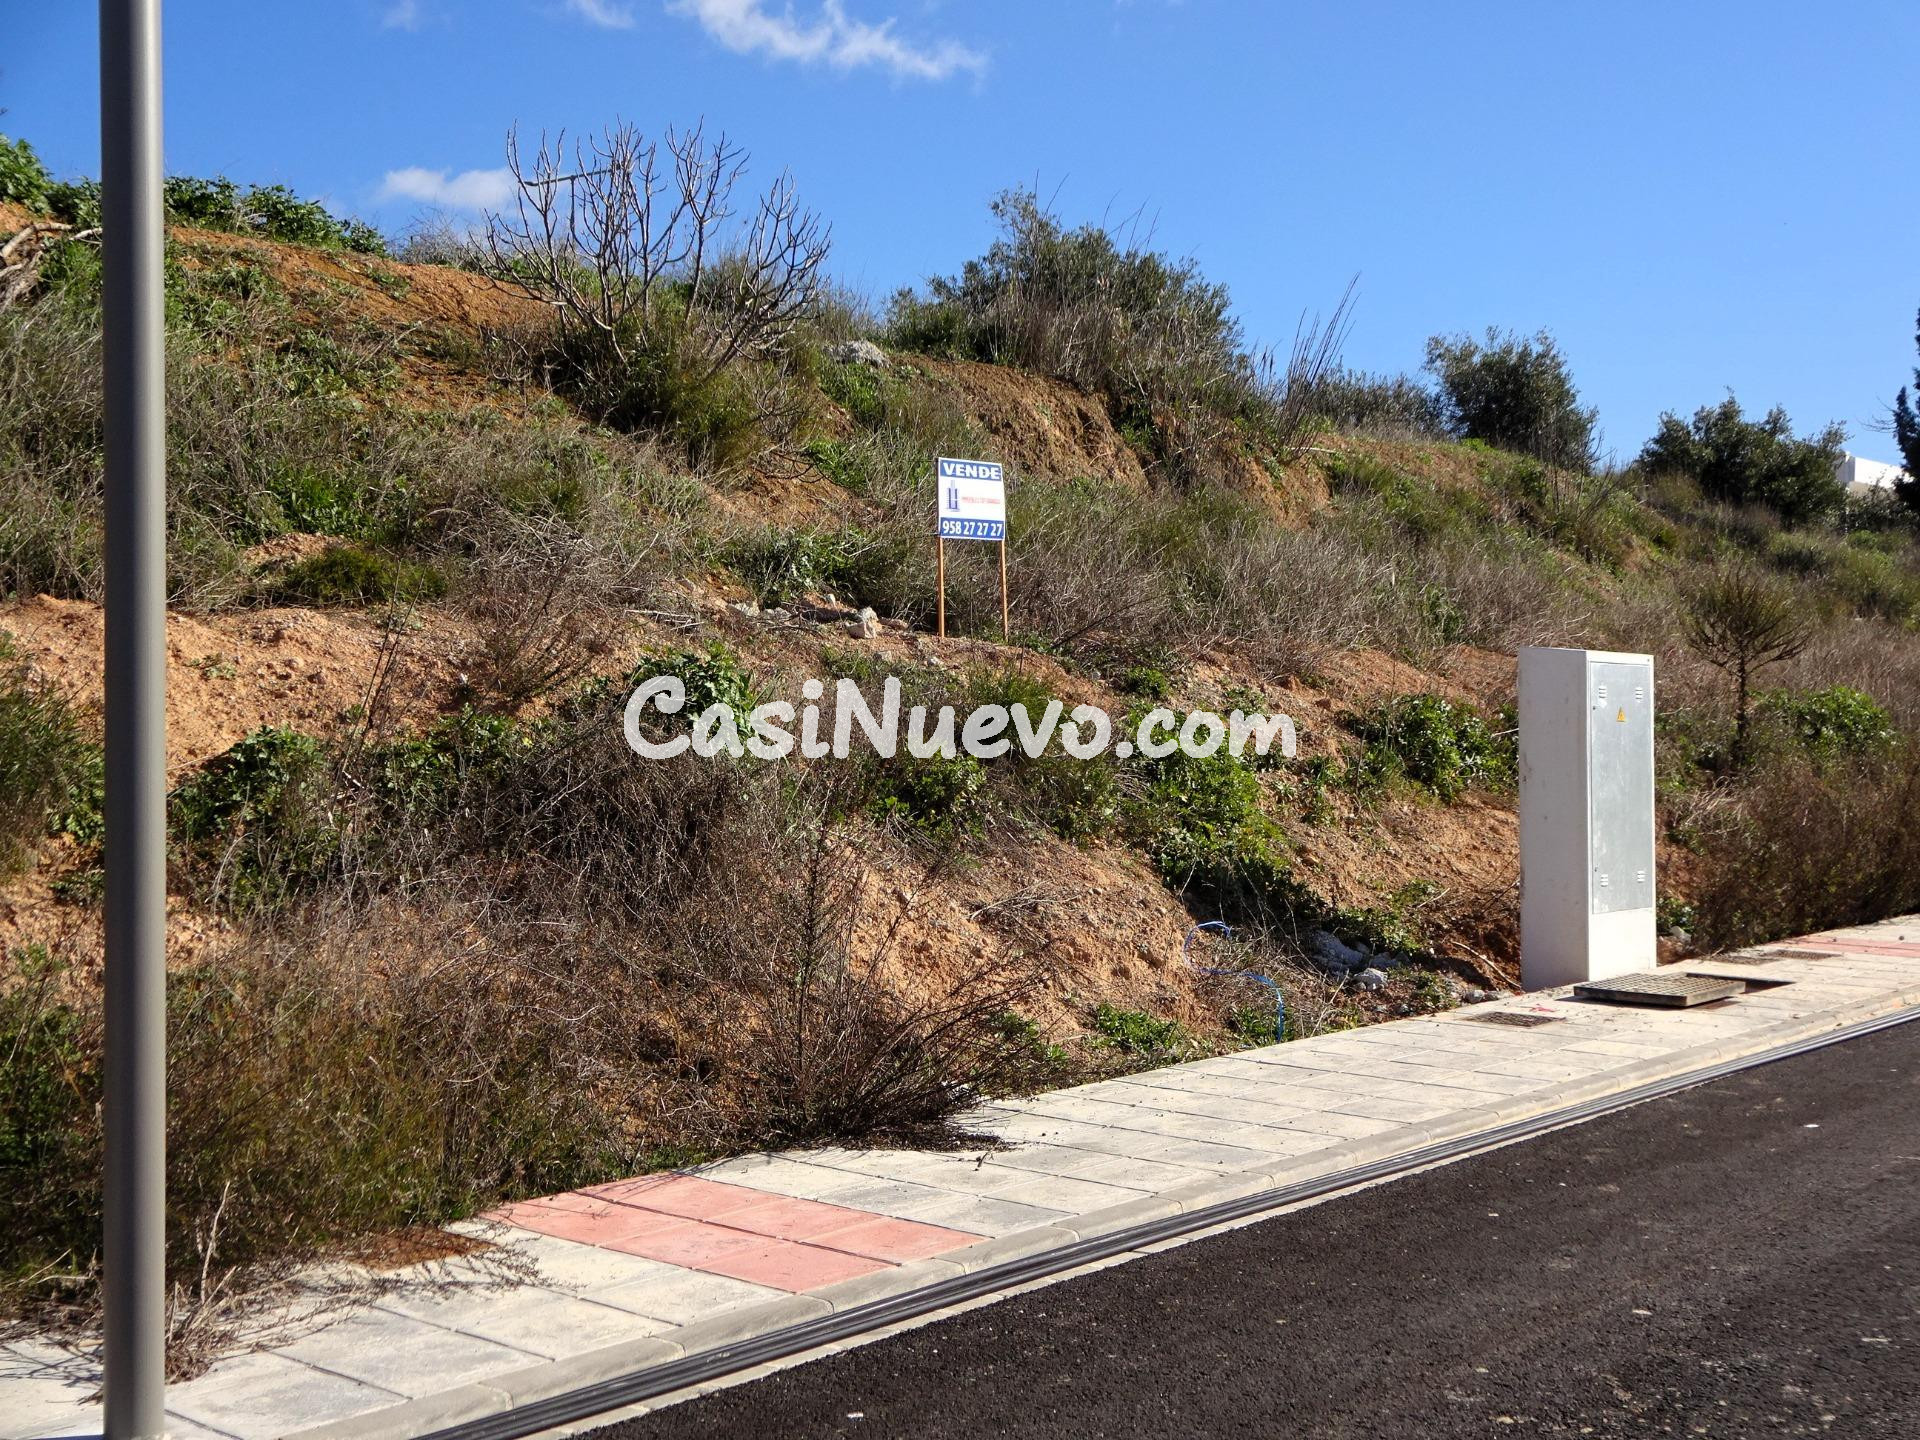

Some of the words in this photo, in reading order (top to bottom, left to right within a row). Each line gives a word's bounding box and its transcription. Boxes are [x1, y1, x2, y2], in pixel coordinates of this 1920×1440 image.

[943, 462, 1000, 480] VENDE
[943, 521, 961, 534] 958
[963, 522, 975, 535] 27
[977, 522, 989, 536] 27
[990, 523, 1003, 537] 27
